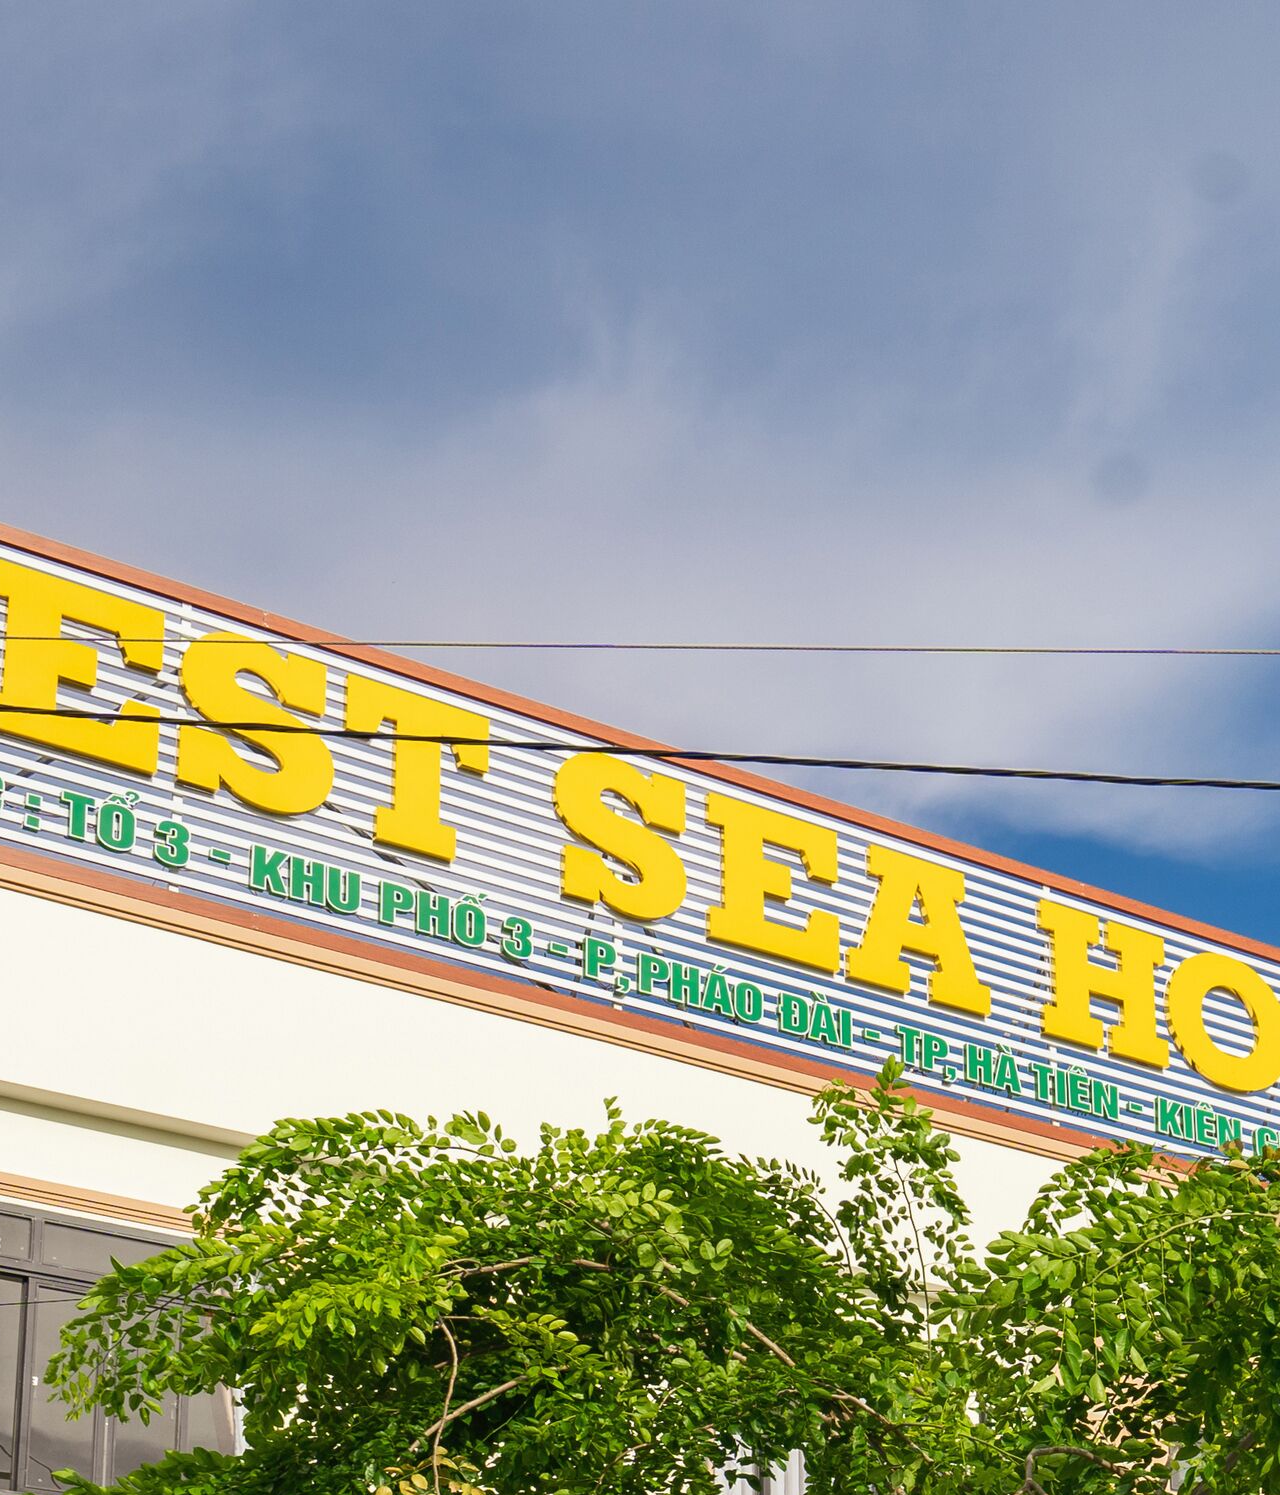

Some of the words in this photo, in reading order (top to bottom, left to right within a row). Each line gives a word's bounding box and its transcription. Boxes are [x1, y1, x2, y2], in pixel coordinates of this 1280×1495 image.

[60, 790, 141, 853] TỔ
[153, 819, 192, 868] 3
[208, 846, 232, 866] -
[250, 843, 362, 915] KHU
[378, 880, 489, 949] PHỐ
[500, 916, 534, 961] 3
[547, 941, 570, 957] -
[637, 951, 764, 1025] PHÁO
[778, 990, 854, 1049] ĐÀI
[862, 1026, 881, 1040] -
[963, 1042, 1022, 1095] HÀ
[1029, 1061, 1120, 1121] TIÊN
[1126, 1100, 1144, 1114] -
[1154, 1094, 1245, 1149] KIÊN
[553, 752, 991, 1018] SEA
